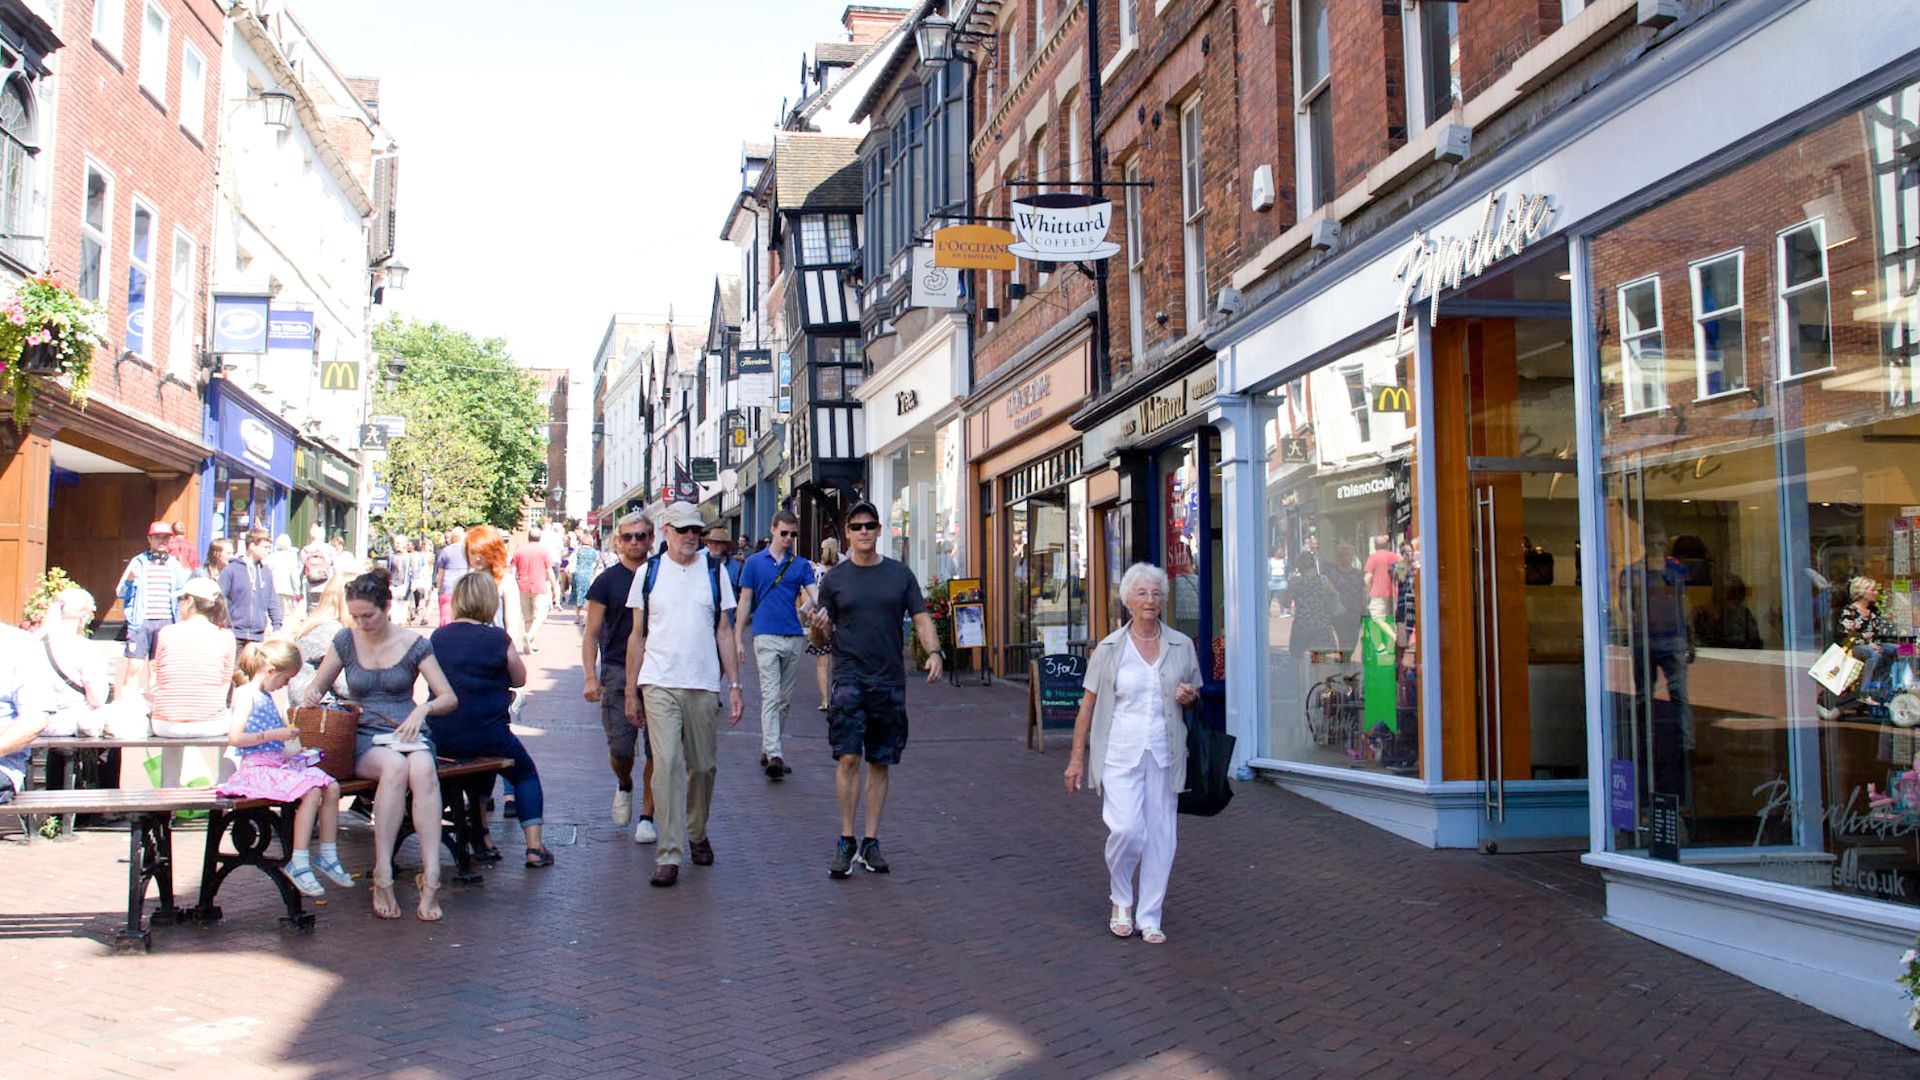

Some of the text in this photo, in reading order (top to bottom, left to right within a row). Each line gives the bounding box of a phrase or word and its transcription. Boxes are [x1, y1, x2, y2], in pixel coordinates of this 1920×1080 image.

[1018, 211, 1105, 234] Whittard
[1035, 236, 1095, 248] COFFEES
[1138, 379, 1186, 436] Whittard
[1044, 657, 1056, 674] 3
[1069, 656, 1082, 676] 2
